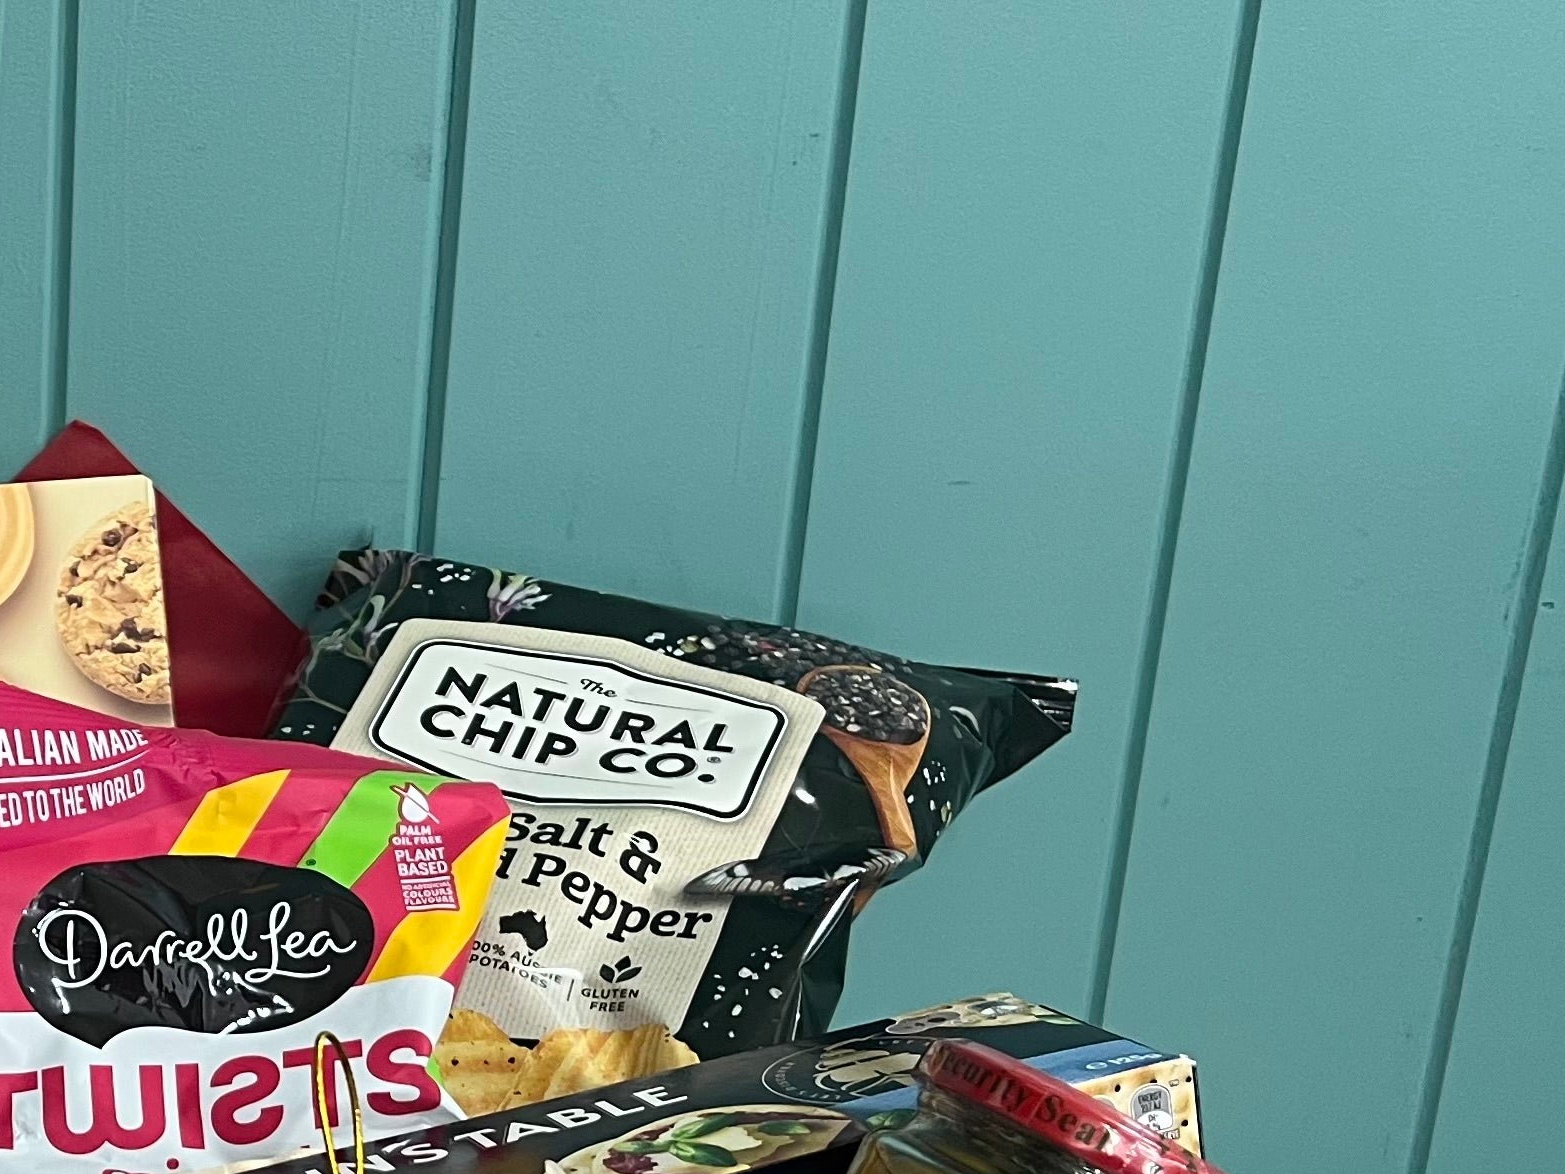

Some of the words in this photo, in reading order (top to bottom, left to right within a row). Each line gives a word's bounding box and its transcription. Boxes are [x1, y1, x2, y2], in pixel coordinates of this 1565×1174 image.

[580, 677, 617, 698] The
[434, 666, 736, 754] NATURAL
[87, 728, 148, 761] MADE
[419, 704, 577, 765] CHIP
[598, 751, 715, 783] CO.
[23, 790, 49, 823] TO
[49, 785, 87, 819] THE
[87, 768, 146, 811] WORLD
[392, 836, 412, 846] OIL
[414, 835, 443, 845] FREE
[399, 825, 432, 836] PALM
[394, 847, 444, 862] PLANT
[505, 812, 614, 858] Salt
[619, 830, 662, 885] &
[397, 860, 448, 877] BASED
[402, 888, 453, 899] COLOURS
[521, 852, 714, 943] Pepper
[38, 908, 258, 989] Darrell
[245, 901, 357, 983] Lea
[581, 988, 639, 999] GLUTEN
[589, 1001, 626, 1012] FREE
[452, 1084, 689, 1147] TABLE
